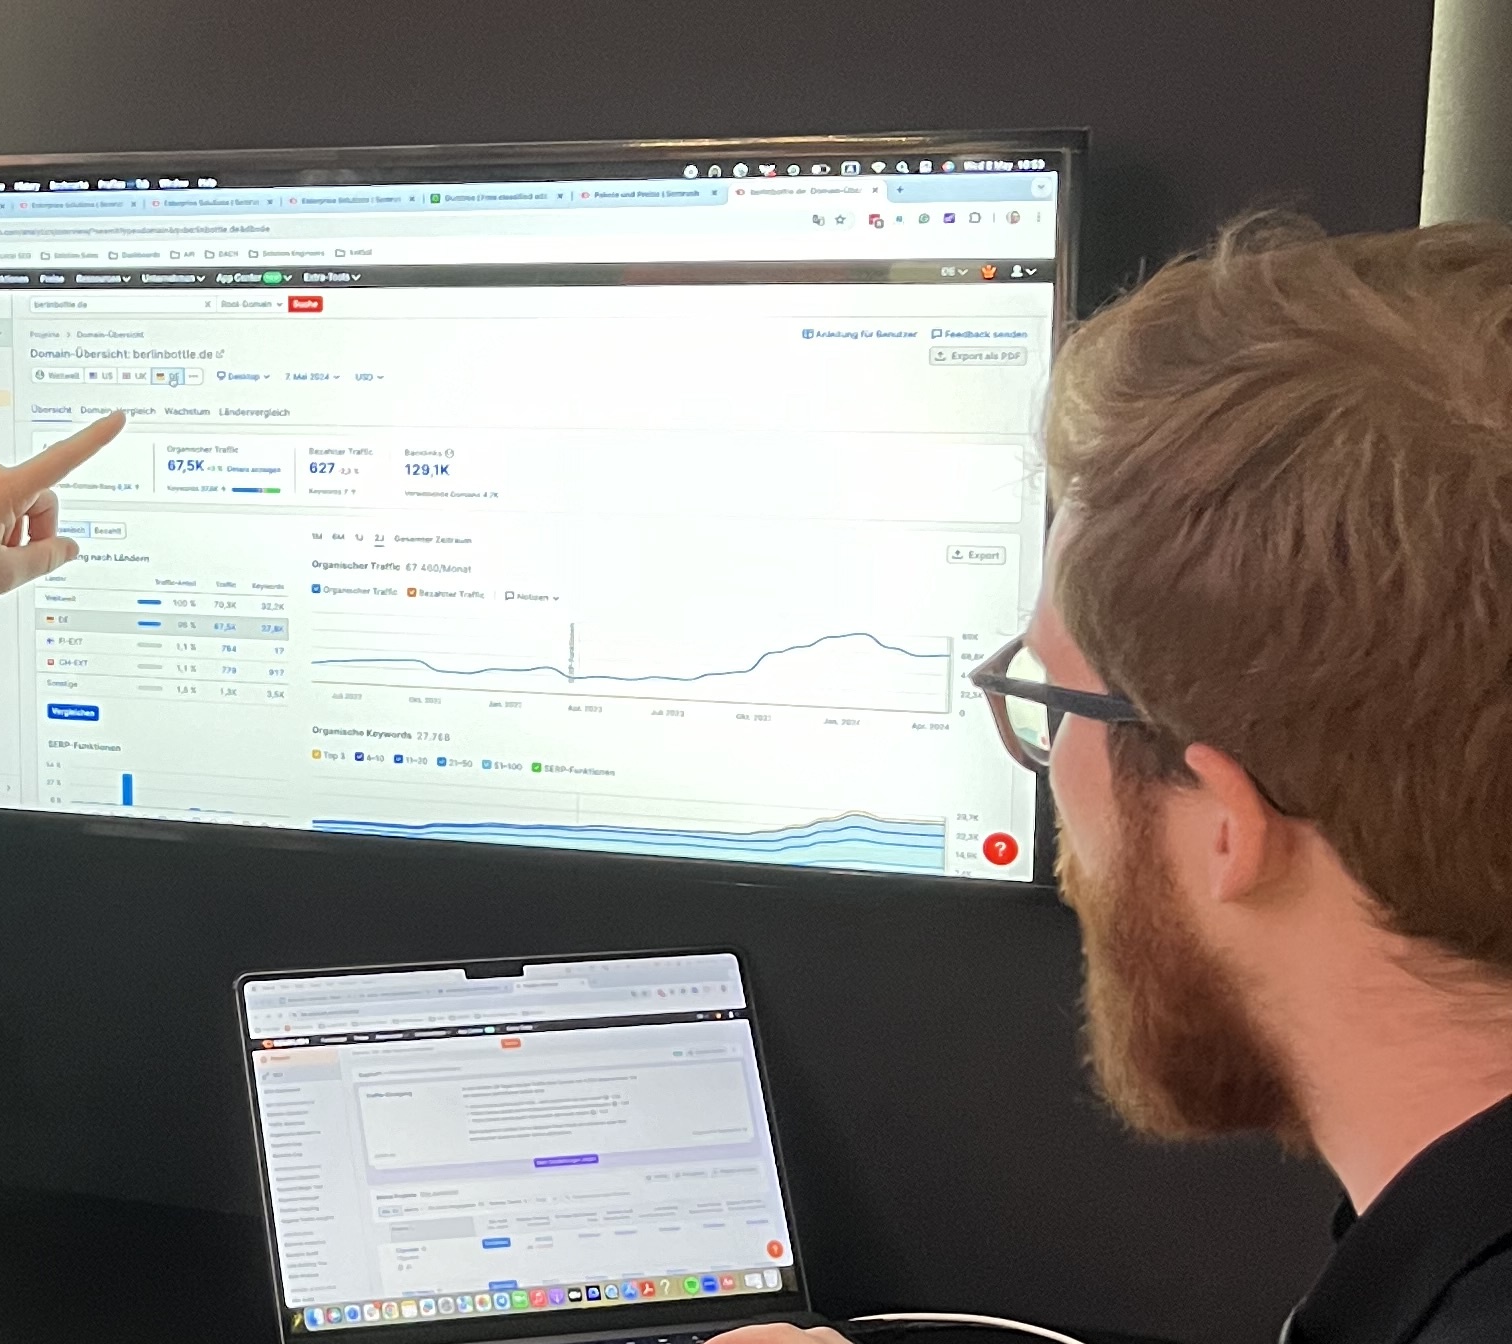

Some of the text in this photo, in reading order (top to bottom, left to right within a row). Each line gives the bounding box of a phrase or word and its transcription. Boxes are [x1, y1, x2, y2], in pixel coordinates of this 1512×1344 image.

[29, 345, 214, 360] Domain-Übersicht: berlinbottle.de
[1000, 350, 1021, 361] PDF
[31, 404, 73, 415] Übersicht
[164, 406, 211, 416] Wachstum
[218, 407, 291, 419] Ländervergleich
[214, 445, 238, 455] Traffic
[167, 458, 205, 474] 67,5K
[309, 461, 335, 475] 627
[404, 463, 450, 478] 129,1K
[91, 553, 113, 563] nach
[114, 553, 150, 564] Ländern
[968, 550, 1000, 562] Export
[311, 559, 369, 571] Organischer
[370, 561, 401, 572] Traffic
[366, 728, 412, 741] Keywords
